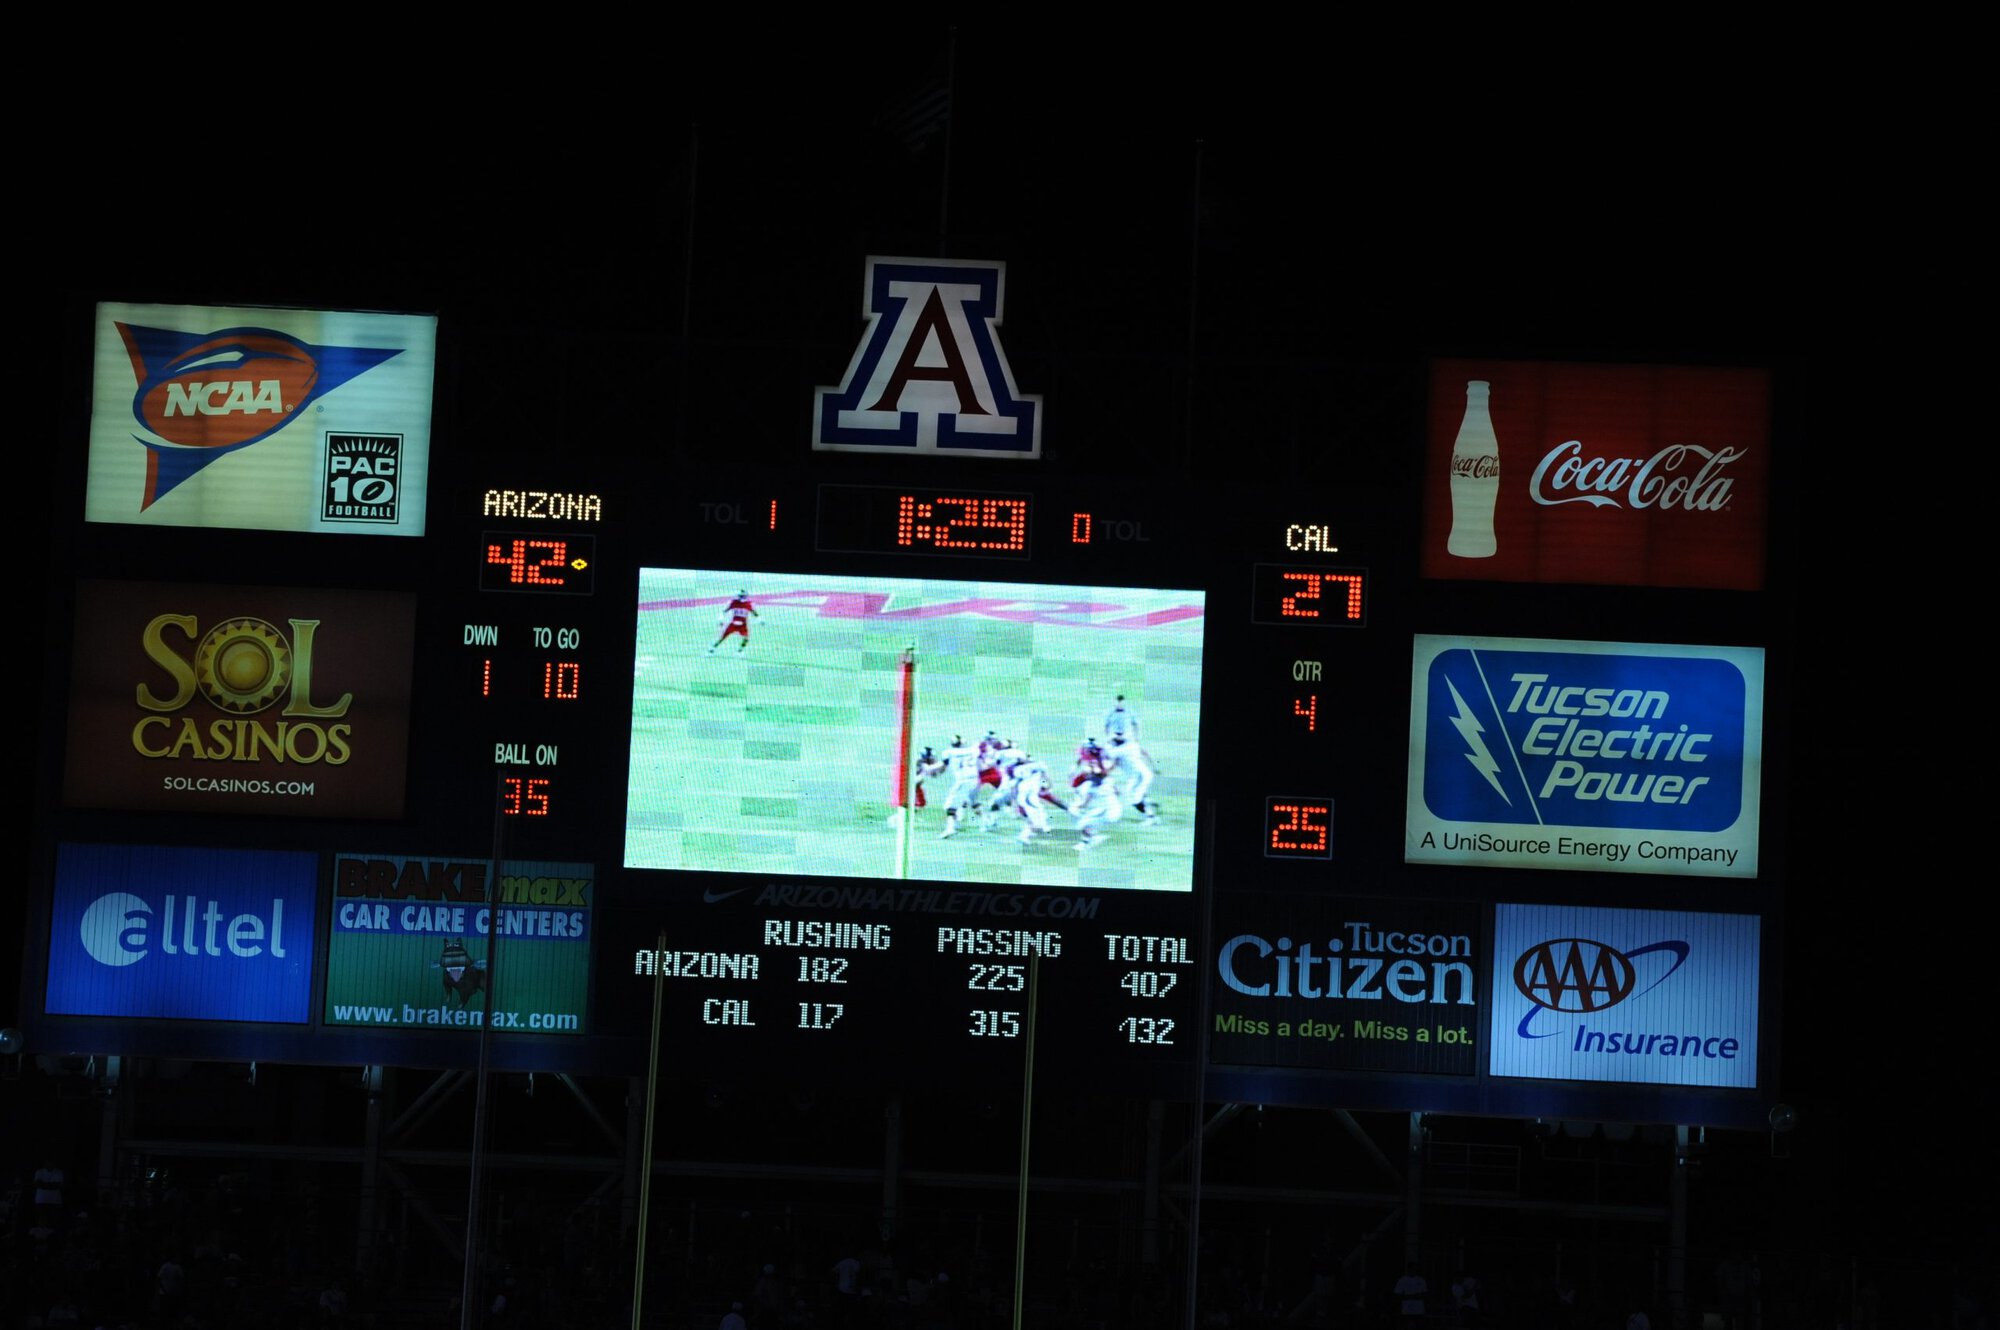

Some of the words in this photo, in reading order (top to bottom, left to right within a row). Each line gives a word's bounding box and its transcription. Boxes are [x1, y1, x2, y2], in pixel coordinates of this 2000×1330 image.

[812, 255, 1043, 460] A
[163, 380, 283, 417] NCAA
[330, 456, 396, 475] PAC
[1529, 439, 1749, 513] Coca-Cola
[330, 477, 394, 504] 10
[483, 489, 601, 521] ARIZONA
[328, 505, 392, 517] FOOTBALL
[702, 502, 748, 524] TOL
[768, 500, 776, 531] 1
[1072, 512, 1091, 544] 0
[1101, 520, 1149, 541] TOL
[1286, 524, 1338, 553] CAL
[487, 539, 566, 585] 42
[1281, 571, 1363, 619] 27
[463, 624, 498, 647] DWN
[533, 627, 557, 649] TO
[558, 629, 580, 651] GO
[135, 613, 353, 718] SOL
[482, 659, 491, 697] 1
[543, 662, 580, 700] 10
[1293, 659, 1322, 682] QTR
[1294, 694, 1317, 732] 4
[1507, 673, 1670, 719] Tucson
[131, 716, 352, 765] CASINOS
[494, 743, 530, 766] BALL
[535, 744, 558, 767] ON
[1521, 717, 1712, 763] Electric
[163, 776, 315, 796] SOLCASINOS.COM
[503, 777, 551, 816] 35
[1539, 760, 1709, 804] Power
[1271, 804, 1328, 851] 25
[1421, 831, 1436, 848] A
[1443, 833, 1550, 855] UniSource
[1558, 838, 1631, 860] Energy
[1637, 841, 1738, 866] Company
[336, 859, 487, 901] BRAKE
[339, 904, 391, 930] CAR
[400, 906, 465, 934] CARE
[752, 884, 1101, 920] ARIZONAATHLETICS.COM
[764, 920, 891, 950] RUSHING
[937, 926, 1062, 958] PASSING
[1104, 934, 1194, 964] TOTAL
[1344, 921, 1472, 957] Tucson
[634, 949, 760, 980] ARIZONA
[798, 956, 848, 984] 182
[967, 964, 1024, 991] 225
[1120, 970, 1178, 998] 407
[1217, 933, 1475, 1006] Citizen
[1526, 943, 1620, 1010] AAA
[703, 998, 756, 1026] CAL
[797, 1003, 844, 1029] 117
[968, 1010, 1020, 1037] 315
[1215, 1014, 1269, 1035] Miss
[1276, 1023, 1291, 1038] a
[1297, 1017, 1345, 1042] day.
[1353, 1020, 1409, 1042] Miss
[1415, 1029, 1430, 1043] a
[1436, 1024, 1473, 1046] lot.
[1574, 1025, 1739, 1059] Insurance
